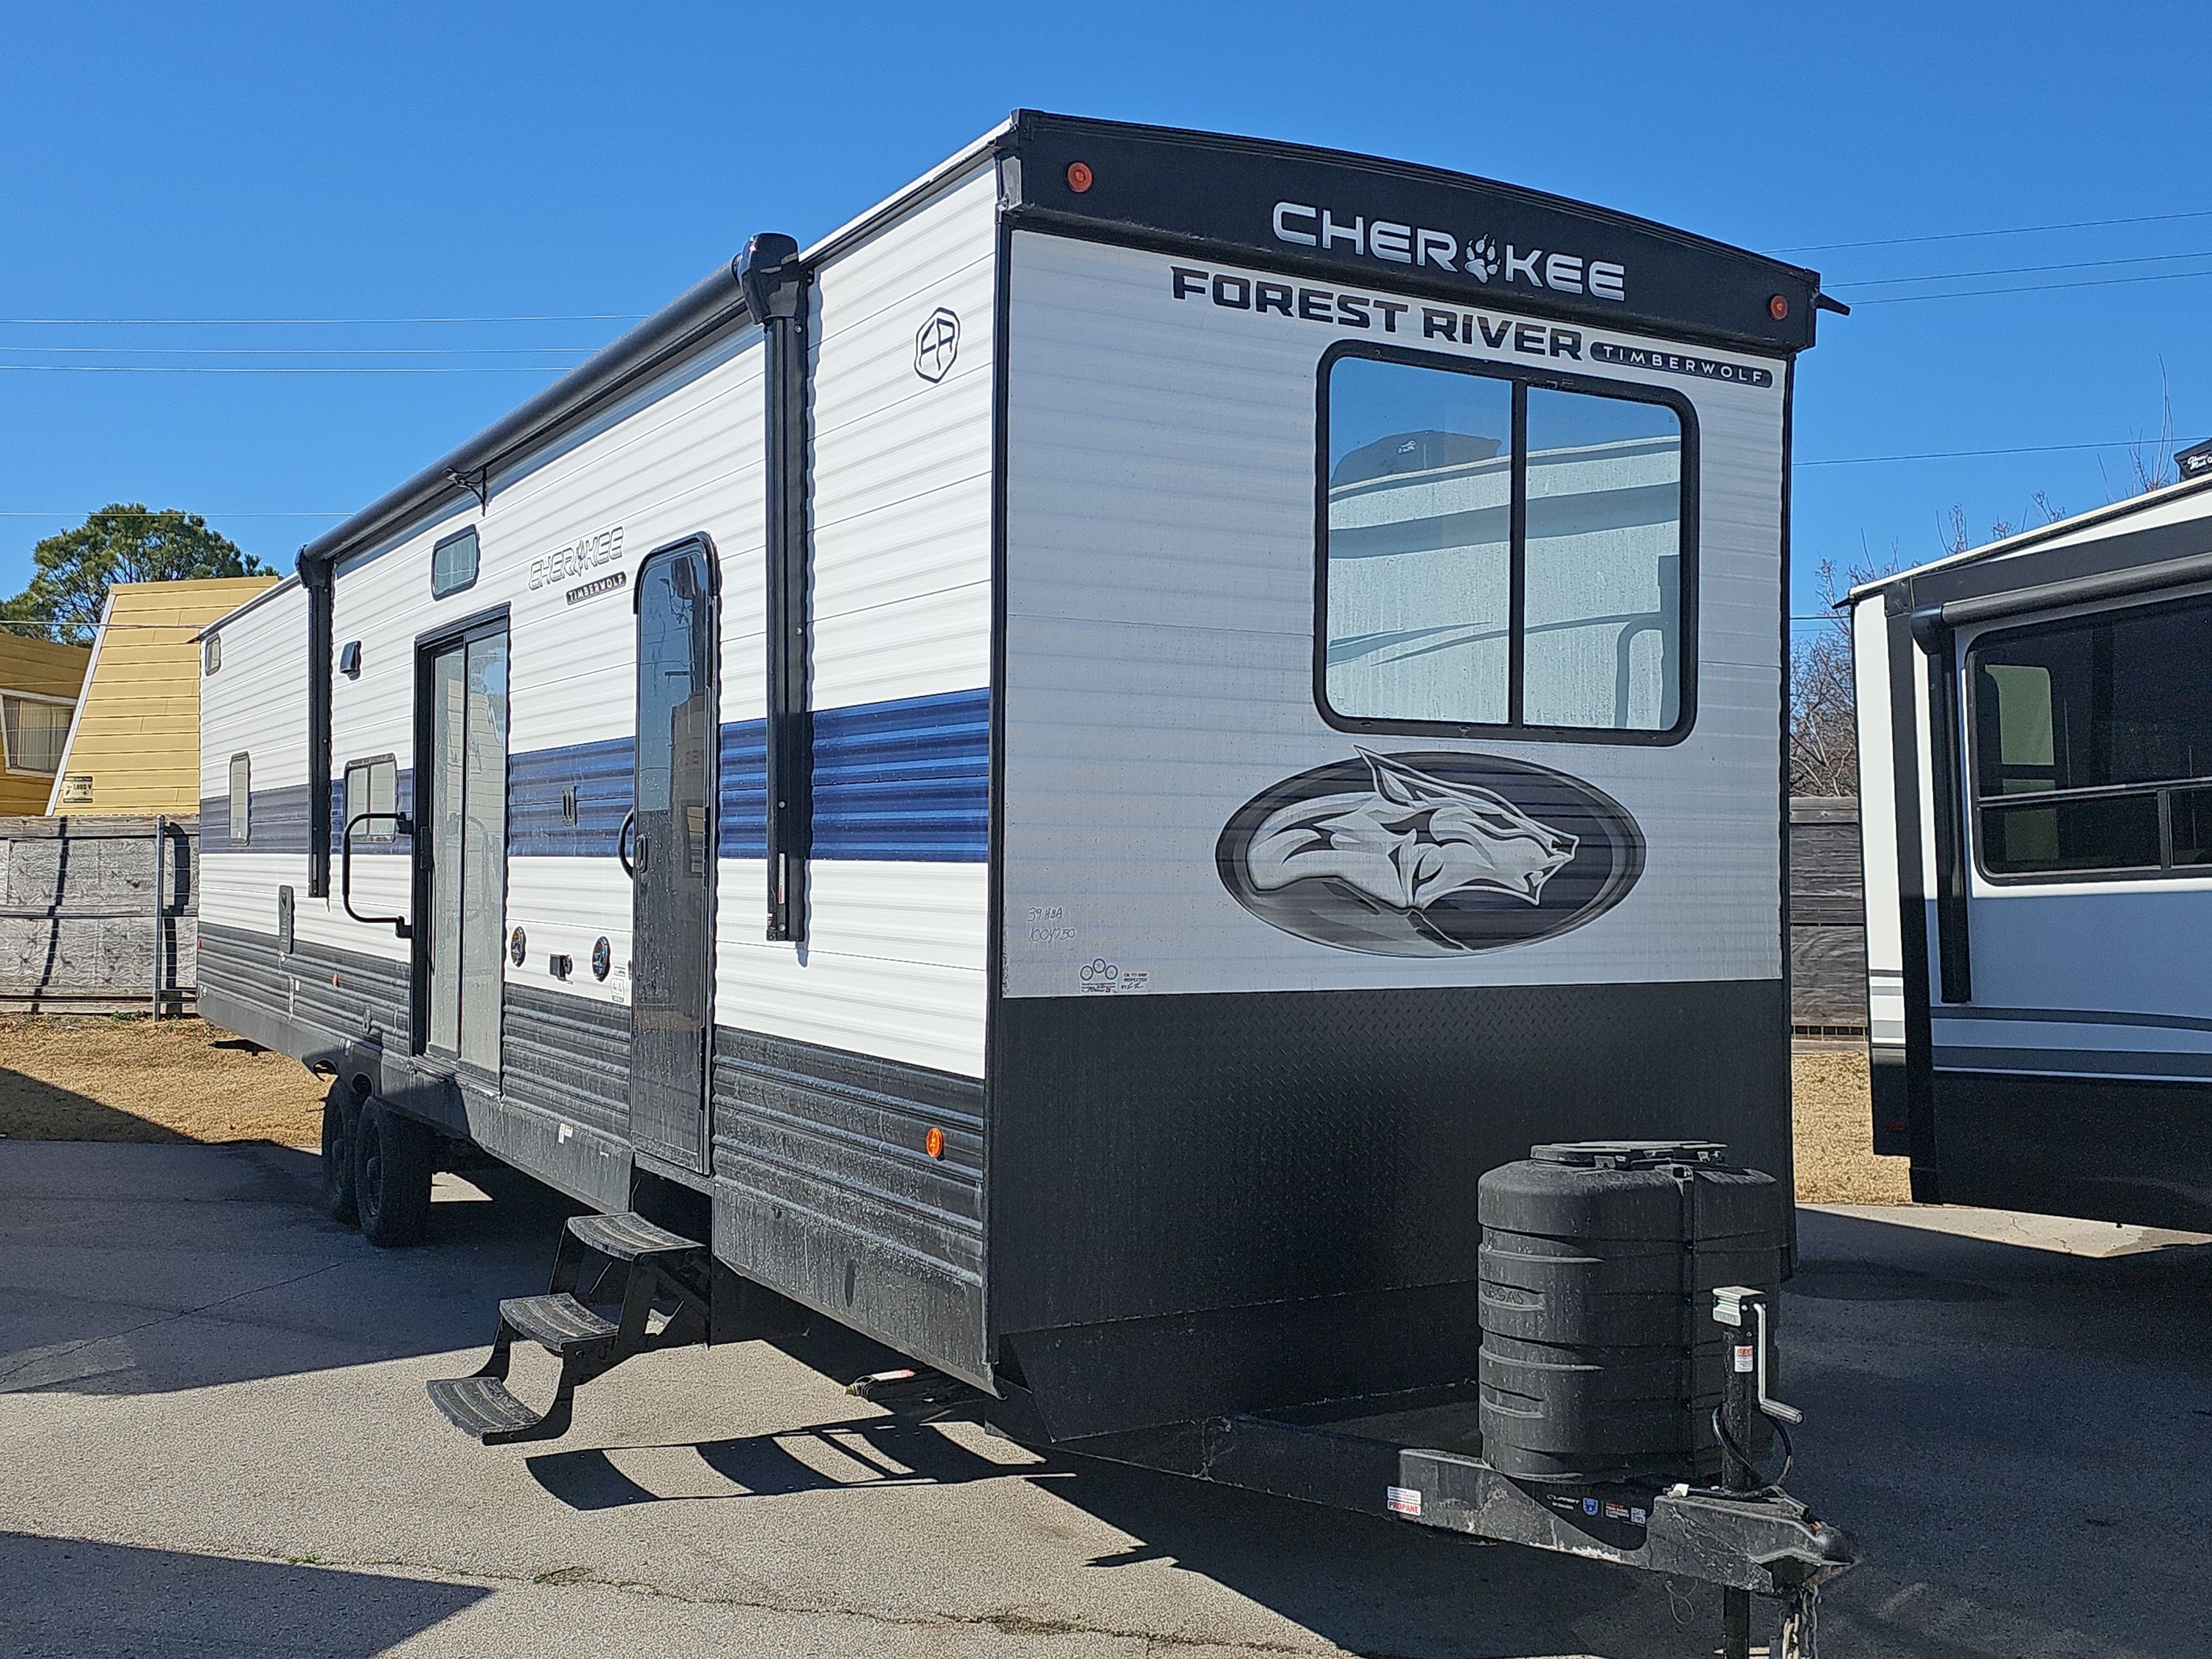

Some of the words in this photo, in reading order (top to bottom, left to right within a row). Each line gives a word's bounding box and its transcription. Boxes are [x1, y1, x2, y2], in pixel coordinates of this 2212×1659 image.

[1169, 265, 1409, 333] FOREST
[1420, 307, 1583, 361] RIVER
[1602, 345, 1763, 384] TIMBERWOLF
[568, 574, 624, 602] TIMBERWOLF
[1388, 1501, 1419, 1514] PROPANE
